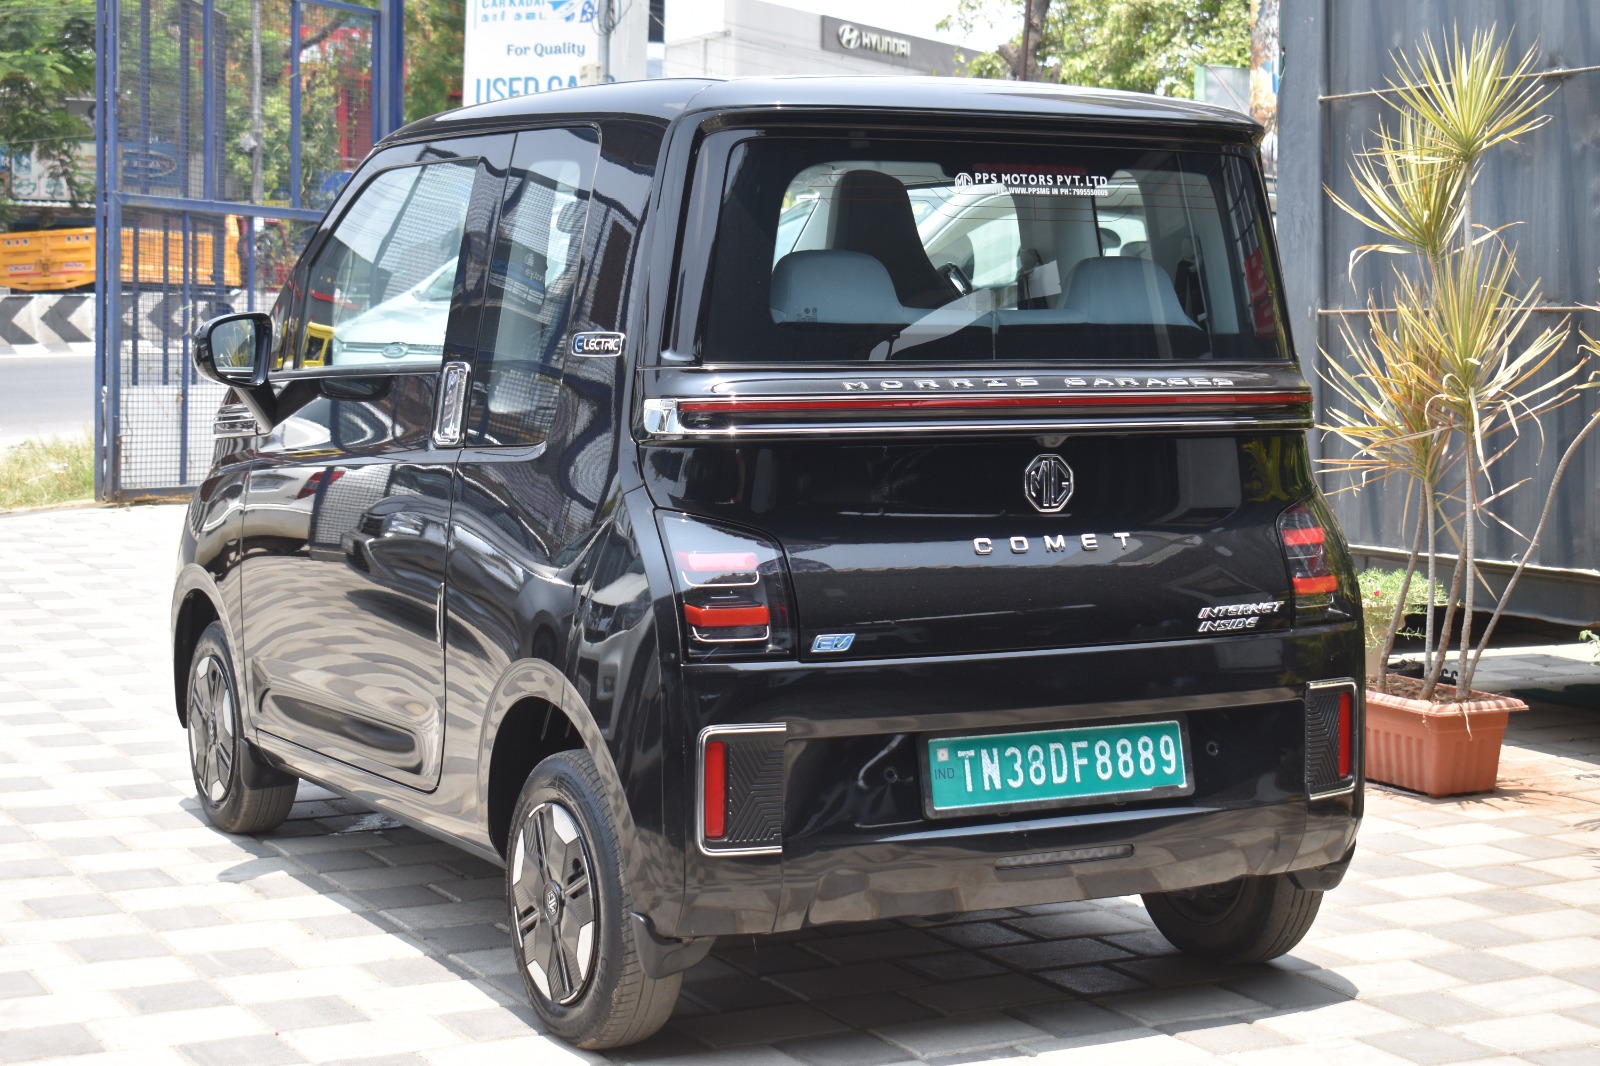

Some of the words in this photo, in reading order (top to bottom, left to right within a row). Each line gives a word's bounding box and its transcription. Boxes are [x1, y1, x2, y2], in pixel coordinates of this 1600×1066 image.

[507, 44, 531, 56] For
[534, 42, 586, 57] Quality
[861, 31, 911, 57] HYUNDAI
[975, 173, 998, 184] PPS
[1001, 173, 1053, 186] MOTORS
[575, 336, 620, 353] ELECTRIC
[842, 377, 1039, 391] MORRIS
[1064, 377, 1234, 388] GARAGES
[1030, 459, 1069, 506] MG
[973, 532, 1130, 555] COMET
[1198, 600, 1285, 619] INTERNET
[1198, 616, 1259, 632] INSIDE
[816, 636, 852, 650] EV
[957, 735, 1176, 792] TN38DF8889
[934, 767, 955, 780] IND
